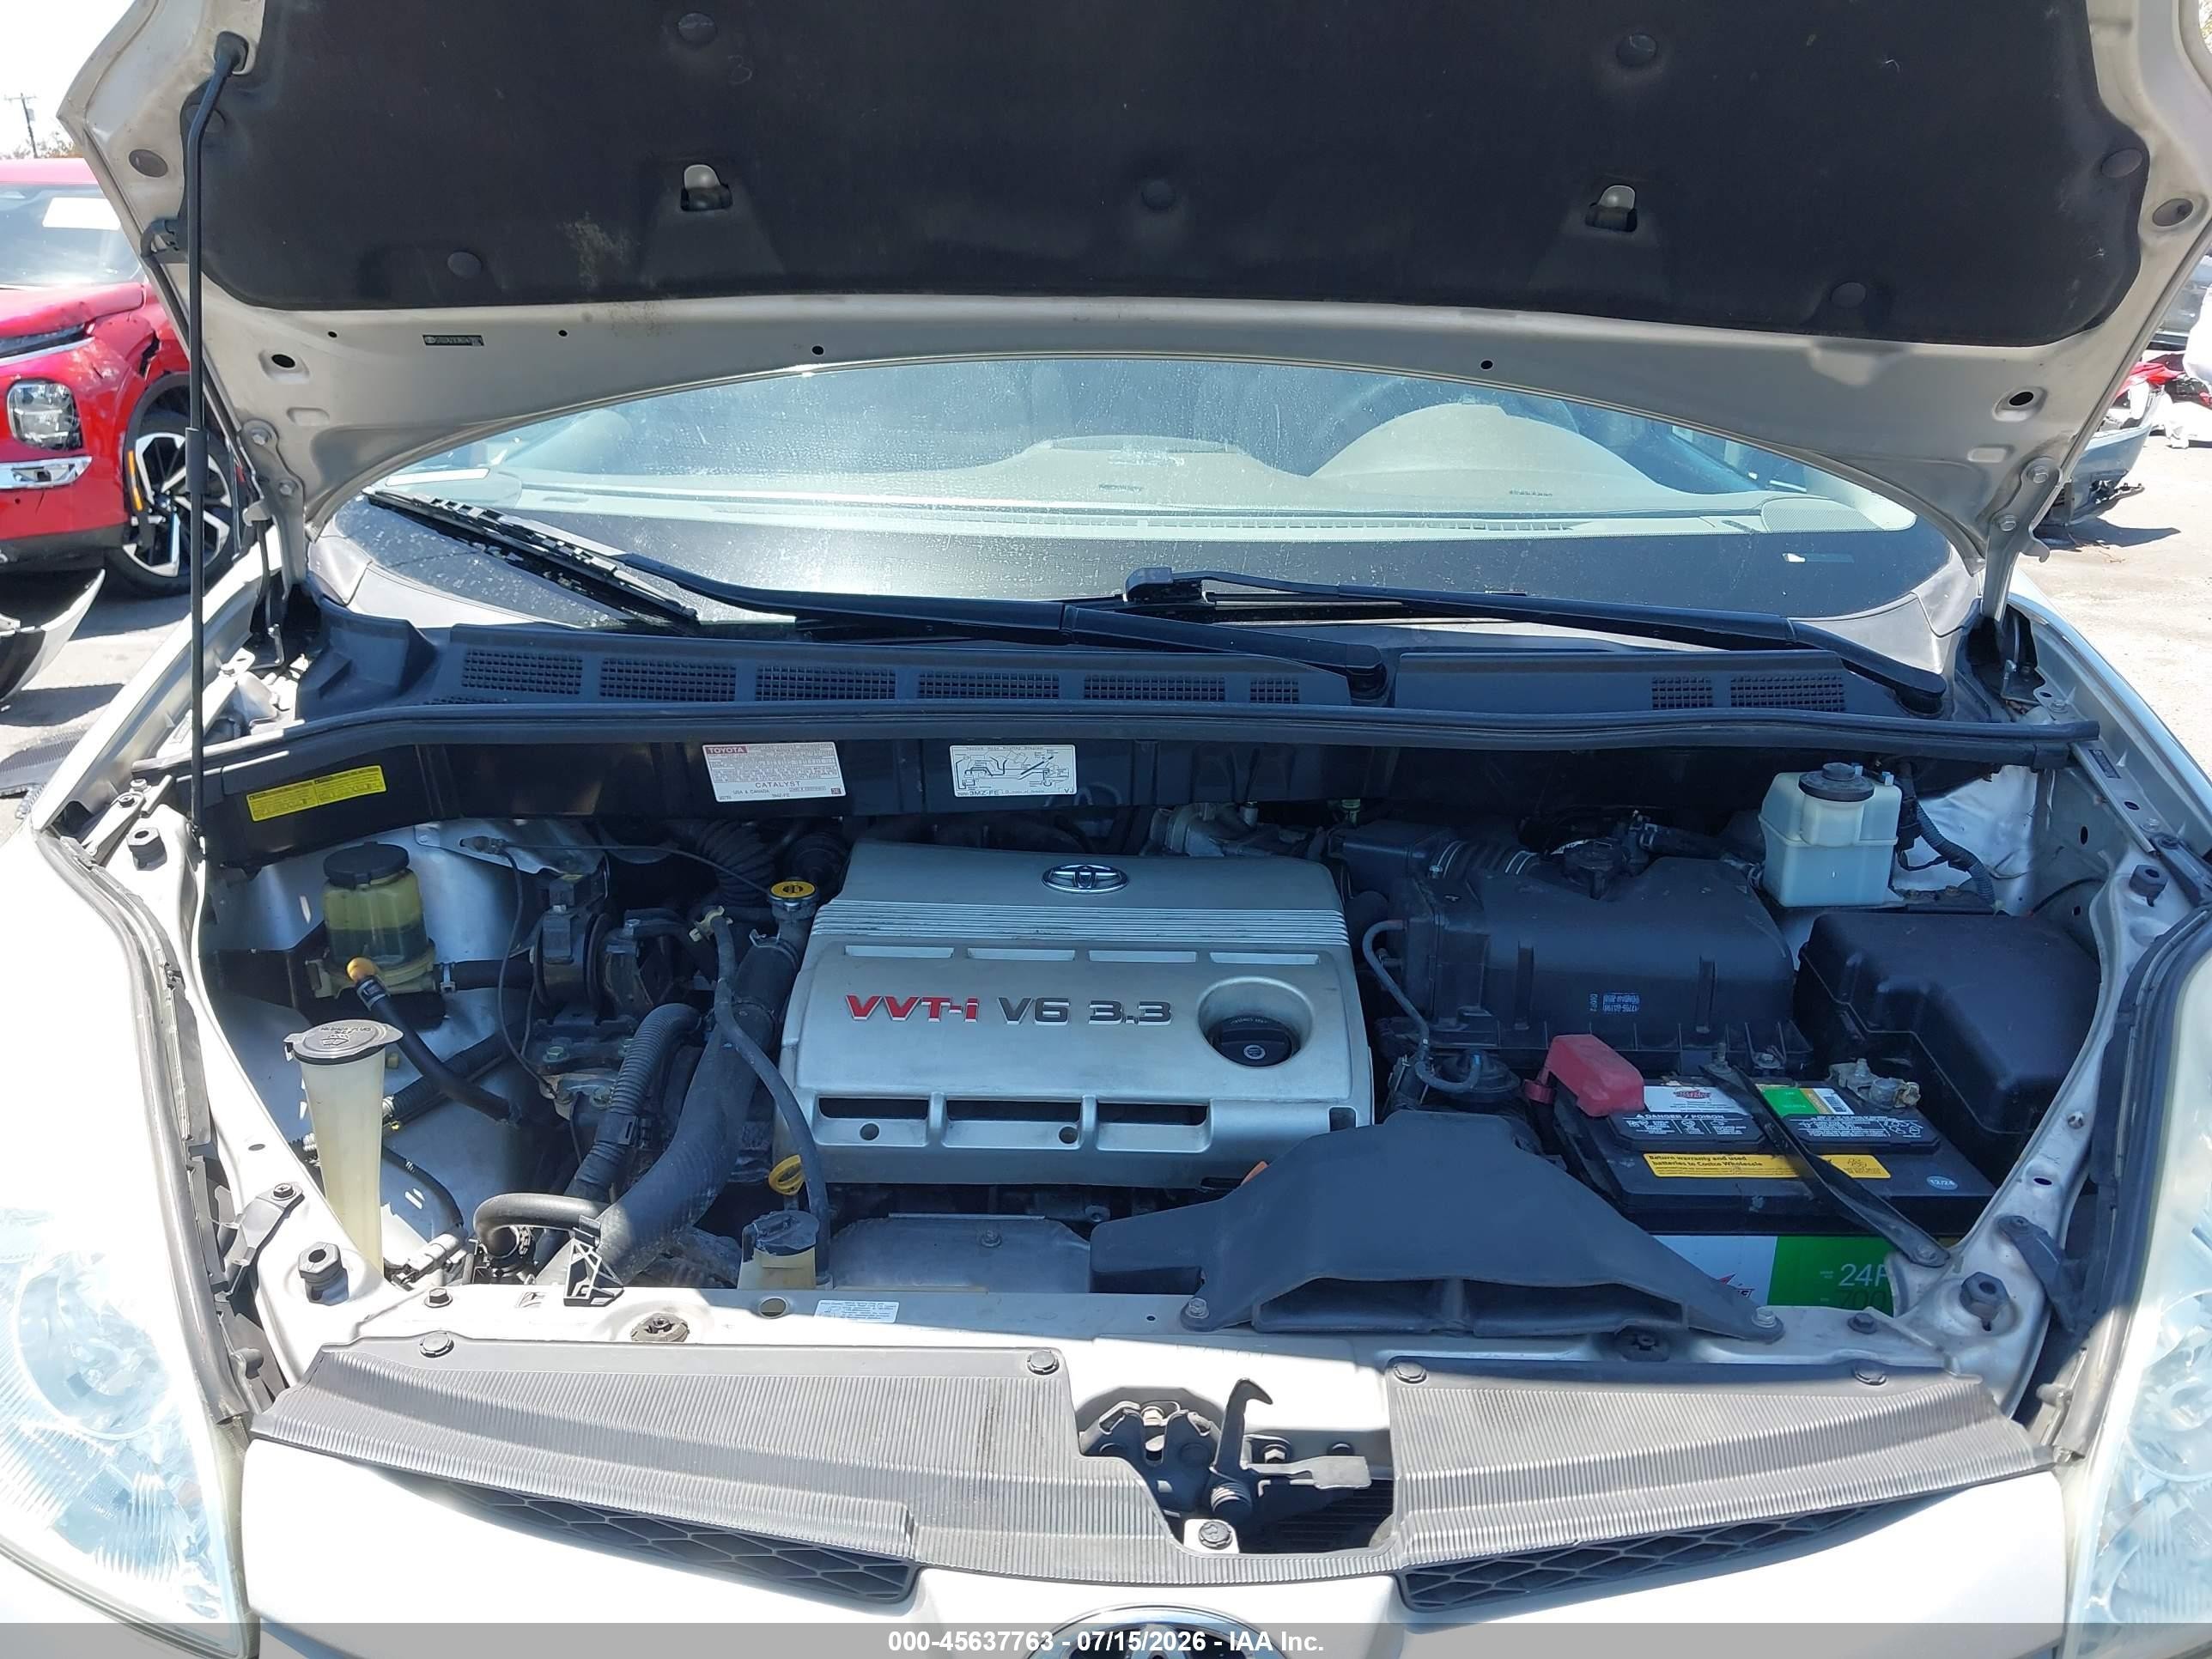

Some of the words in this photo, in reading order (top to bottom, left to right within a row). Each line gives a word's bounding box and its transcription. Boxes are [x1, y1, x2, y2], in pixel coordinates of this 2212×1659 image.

[845, 995, 978, 1024] VVT-i
[998, 997, 1069, 1025] V6
[1088, 1000, 1172, 1025] 3.3
